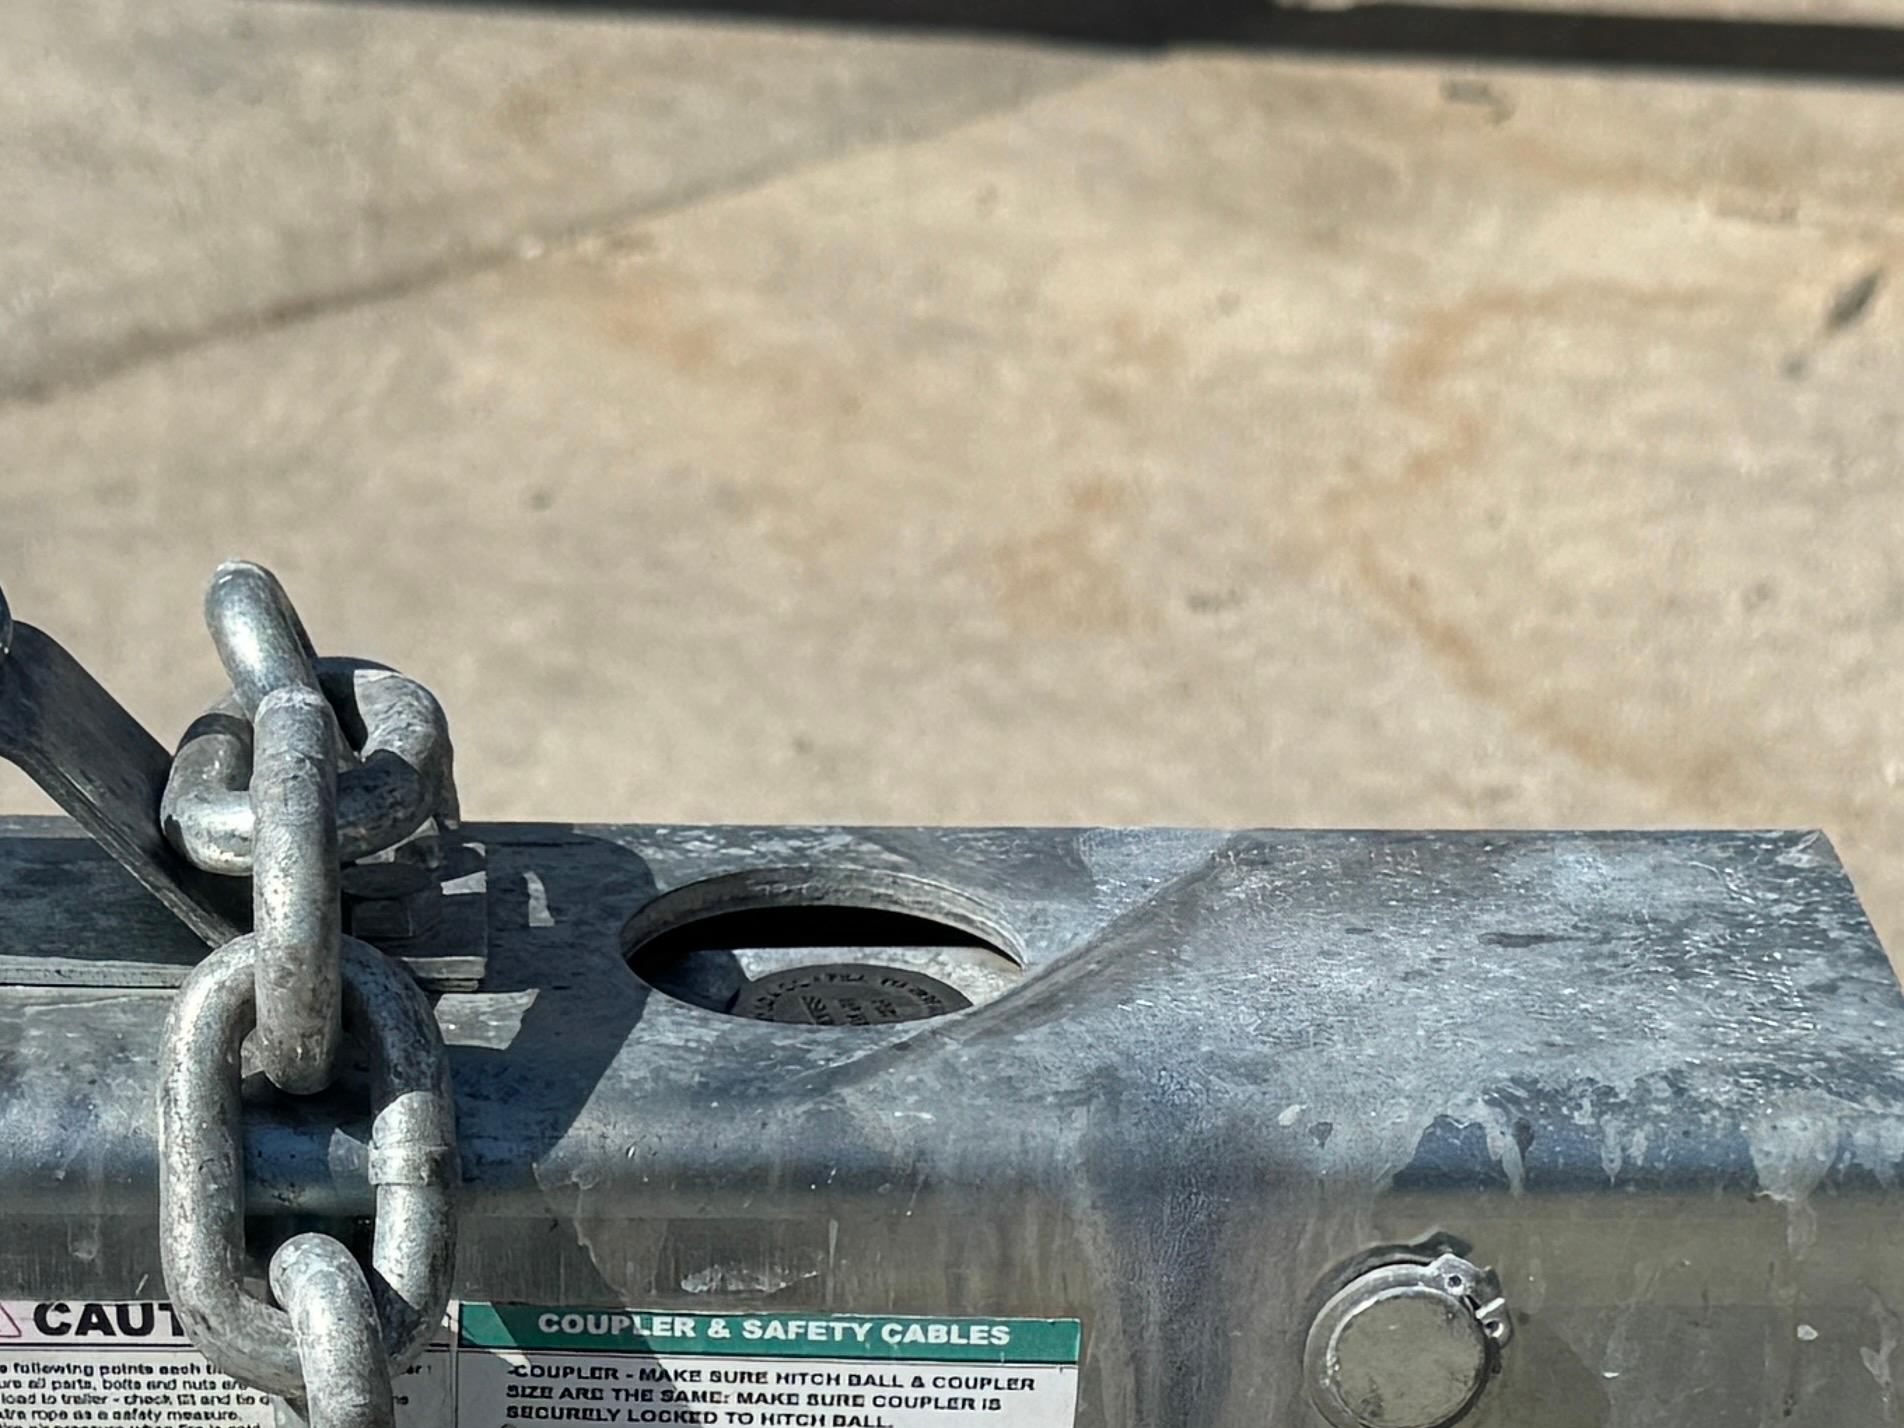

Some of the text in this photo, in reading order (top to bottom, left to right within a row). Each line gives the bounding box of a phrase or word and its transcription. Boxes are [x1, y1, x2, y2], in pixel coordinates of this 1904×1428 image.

[33, 1302, 185, 1337] CAUT
[538, 1312, 1011, 1346] COUPLER & SAFETY CABLES
[14, 1362, 94, 1377] following
[99, 1363, 153, 1377] points
[159, 1363, 201, 1375] each
[639, 1367, 703, 1384] MAKE
[709, 1369, 769, 1385] SURE
[775, 1371, 841, 1387] HITCH
[847, 1373, 904, 1389] BALL
[931, 1375, 1036, 1391] COUPLER
[28, 1377, 46, 1389] all
[102, 1379, 141, 1390] bolts
[146, 1379, 177, 1390] and
[182, 1379, 216, 1390] nuts
[1, 1392, 36, 1405] load
[41, 1393, 57, 1405] to
[61, 1393, 108, 1405] trailer
[200, 1394, 231, 1405] and
[505, 1384, 554, 1400] SIZE
[559, 1385, 604, 1401] ARE
[611, 1387, 653, 1402] THE
[737, 1391, 800, 1406] MAKE
[806, 1393, 865, 1408] SURE
[871, 1394, 976, 1411] COUPLER
[981, 1398, 1002, 1411] IS
[32, 1411, 68, 1421] rope
[112, 1408, 162, 1422] safety
[505, 1405, 622, 1422] SECURELY
[626, 1408, 719, 1426] LOCKED
[725, 1411, 755, 1426] TO
[760, 1413, 826, 1428] HITCH
